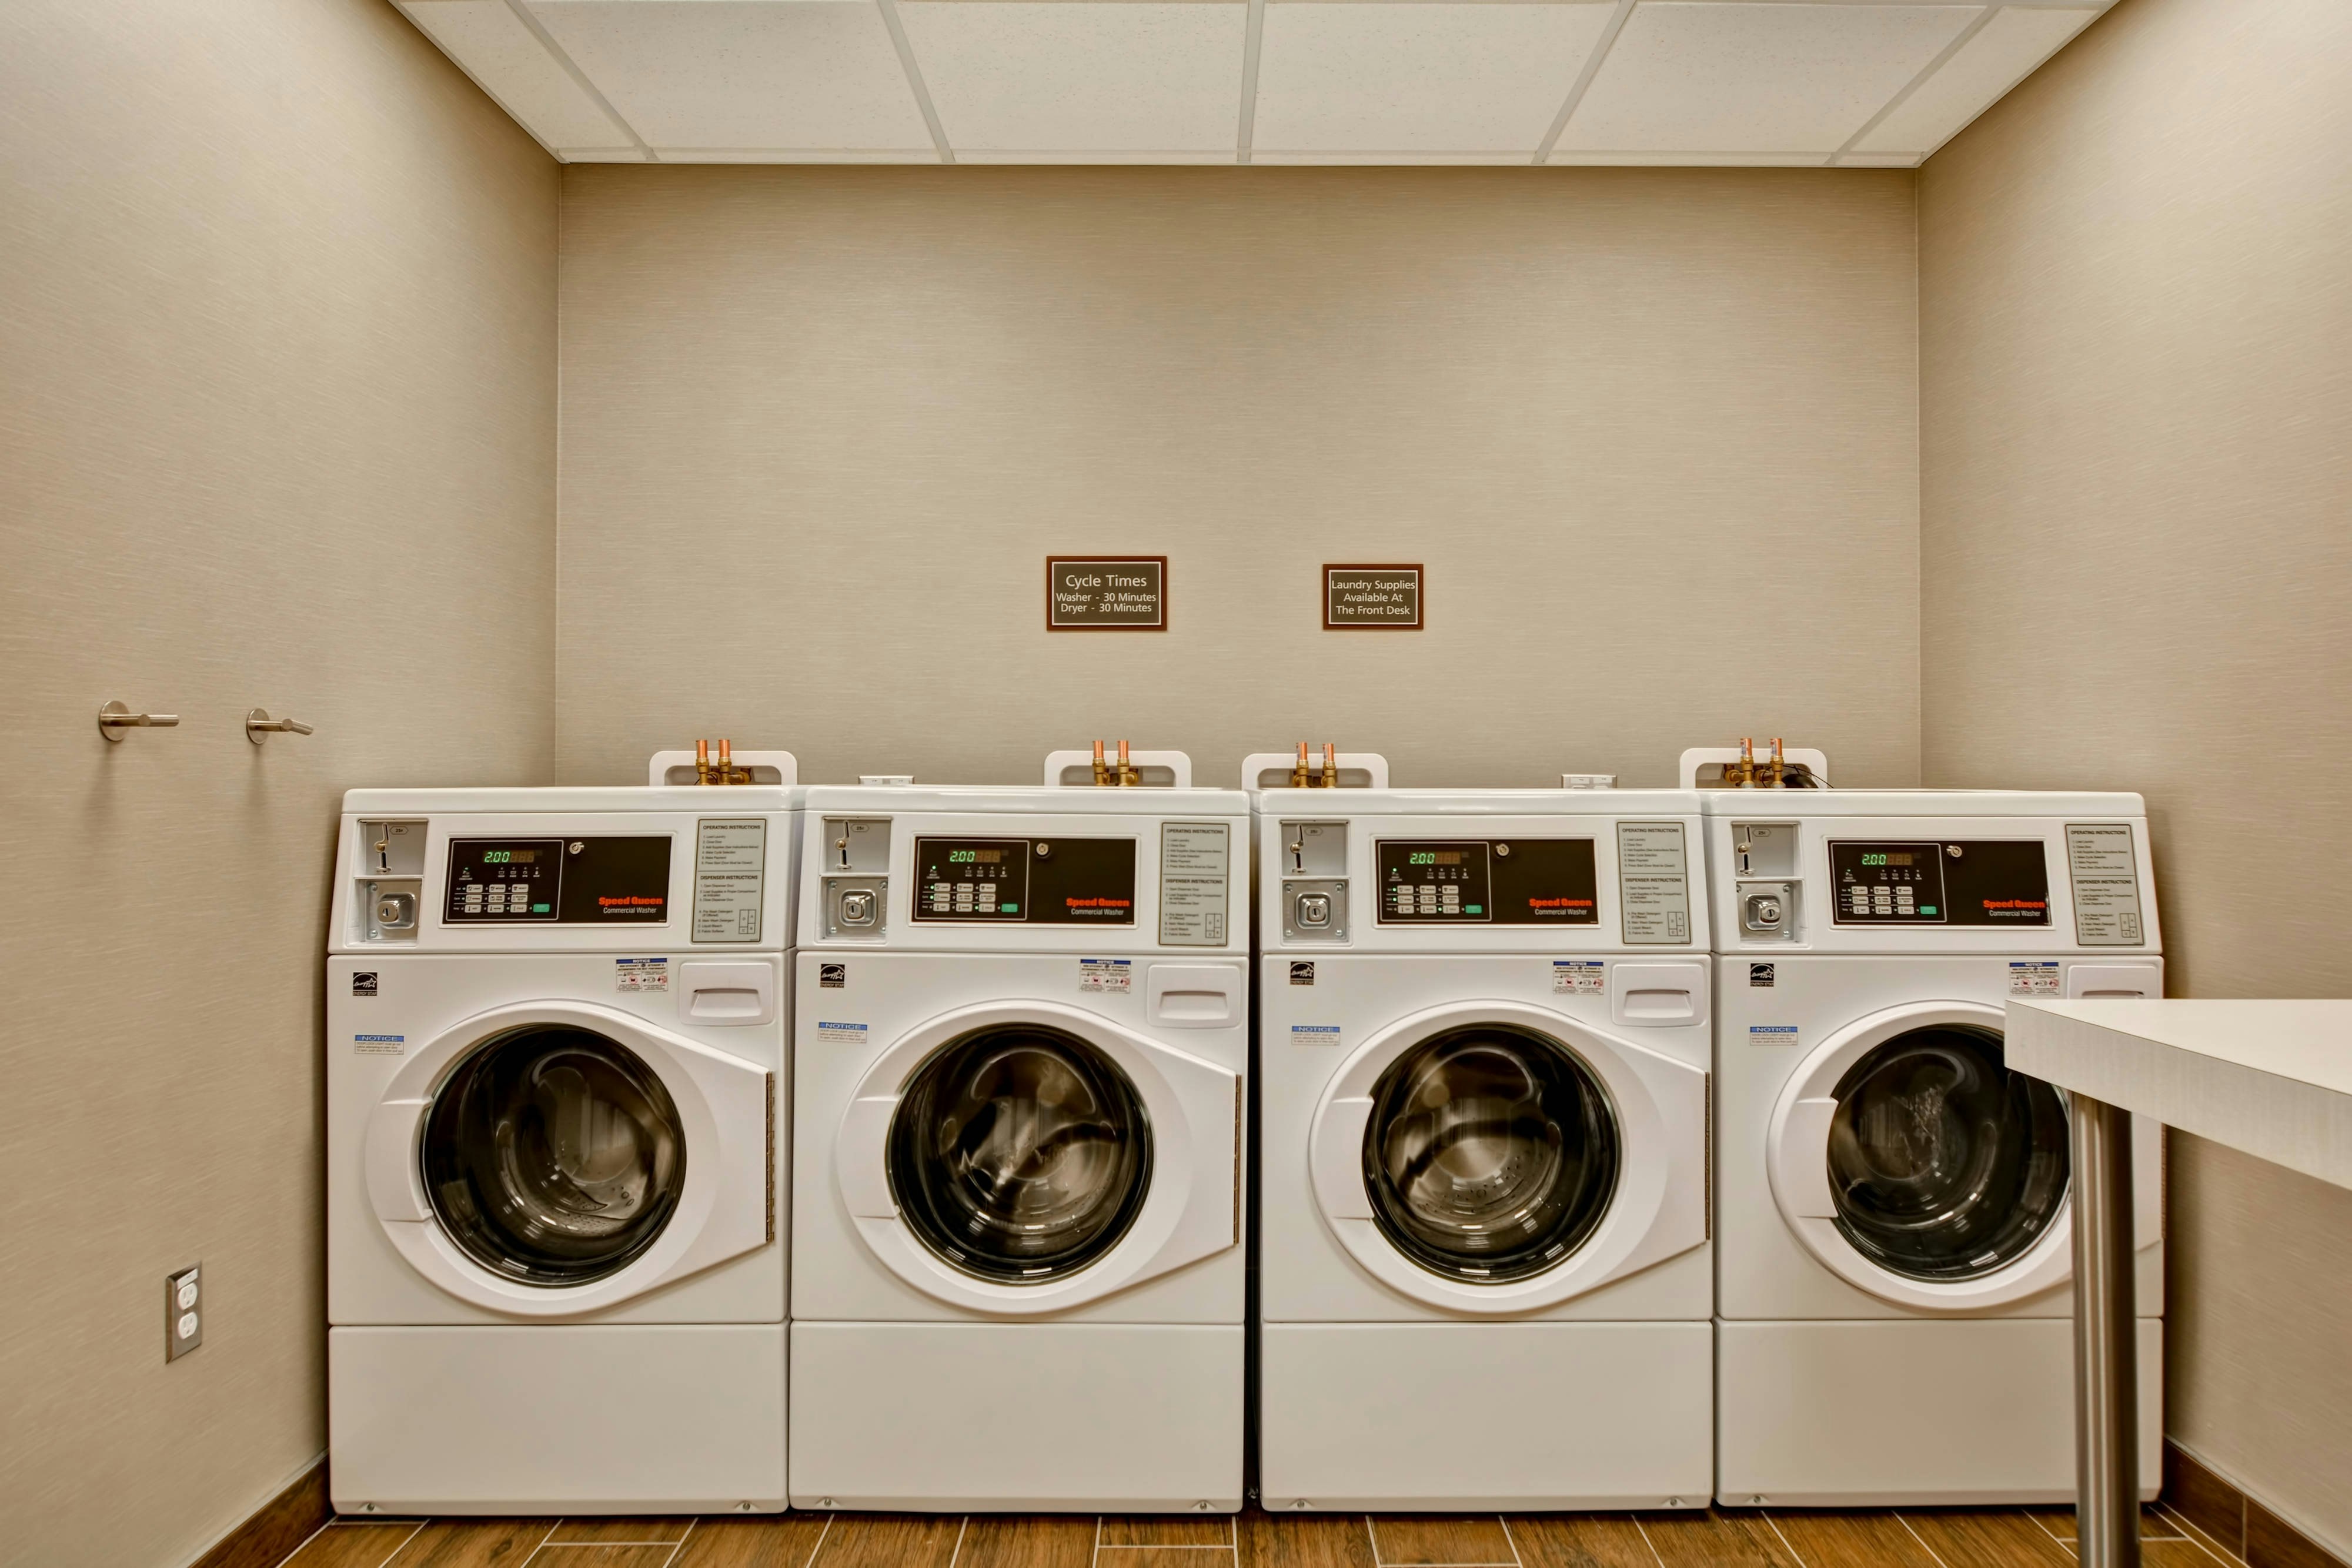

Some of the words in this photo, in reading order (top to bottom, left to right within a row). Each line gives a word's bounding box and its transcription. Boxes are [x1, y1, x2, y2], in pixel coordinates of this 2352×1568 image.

[1065, 574, 1101, 587] Cycle
[1105, 574, 1147, 587] Times
[1332, 580, 1372, 591] Laundry
[1375, 580, 1415, 591] Supplies
[1056, 593, 1092, 602] Washer
[1104, 593, 1115, 602] 30
[1118, 592, 1157, 602] Minutes
[1344, 593, 1388, 602] Available
[1391, 593, 1403, 602] At
[1061, 603, 1087, 614] Dryer
[1099, 603, 1111, 612] 30
[1114, 603, 1152, 612] Minutes
[1336, 605, 1355, 614] The
[1358, 606, 1383, 615] Front
[1387, 606, 1411, 615] Desk
[484, 851, 510, 863] 2.00
[949, 851, 976, 862] 2.00
[1409, 852, 1435, 864] 2.00
[1862, 854, 1886, 865] 2.00
[599, 897, 630, 906] Speed
[631, 897, 663, 905] Queen
[1066, 898, 1097, 907] Speed
[1098, 898, 1130, 907] Queen
[1529, 898, 1560, 908] Speed
[1561, 898, 1592, 907] Queen
[1983, 900, 2014, 909] Speed
[2014, 900, 2046, 908] Queen
